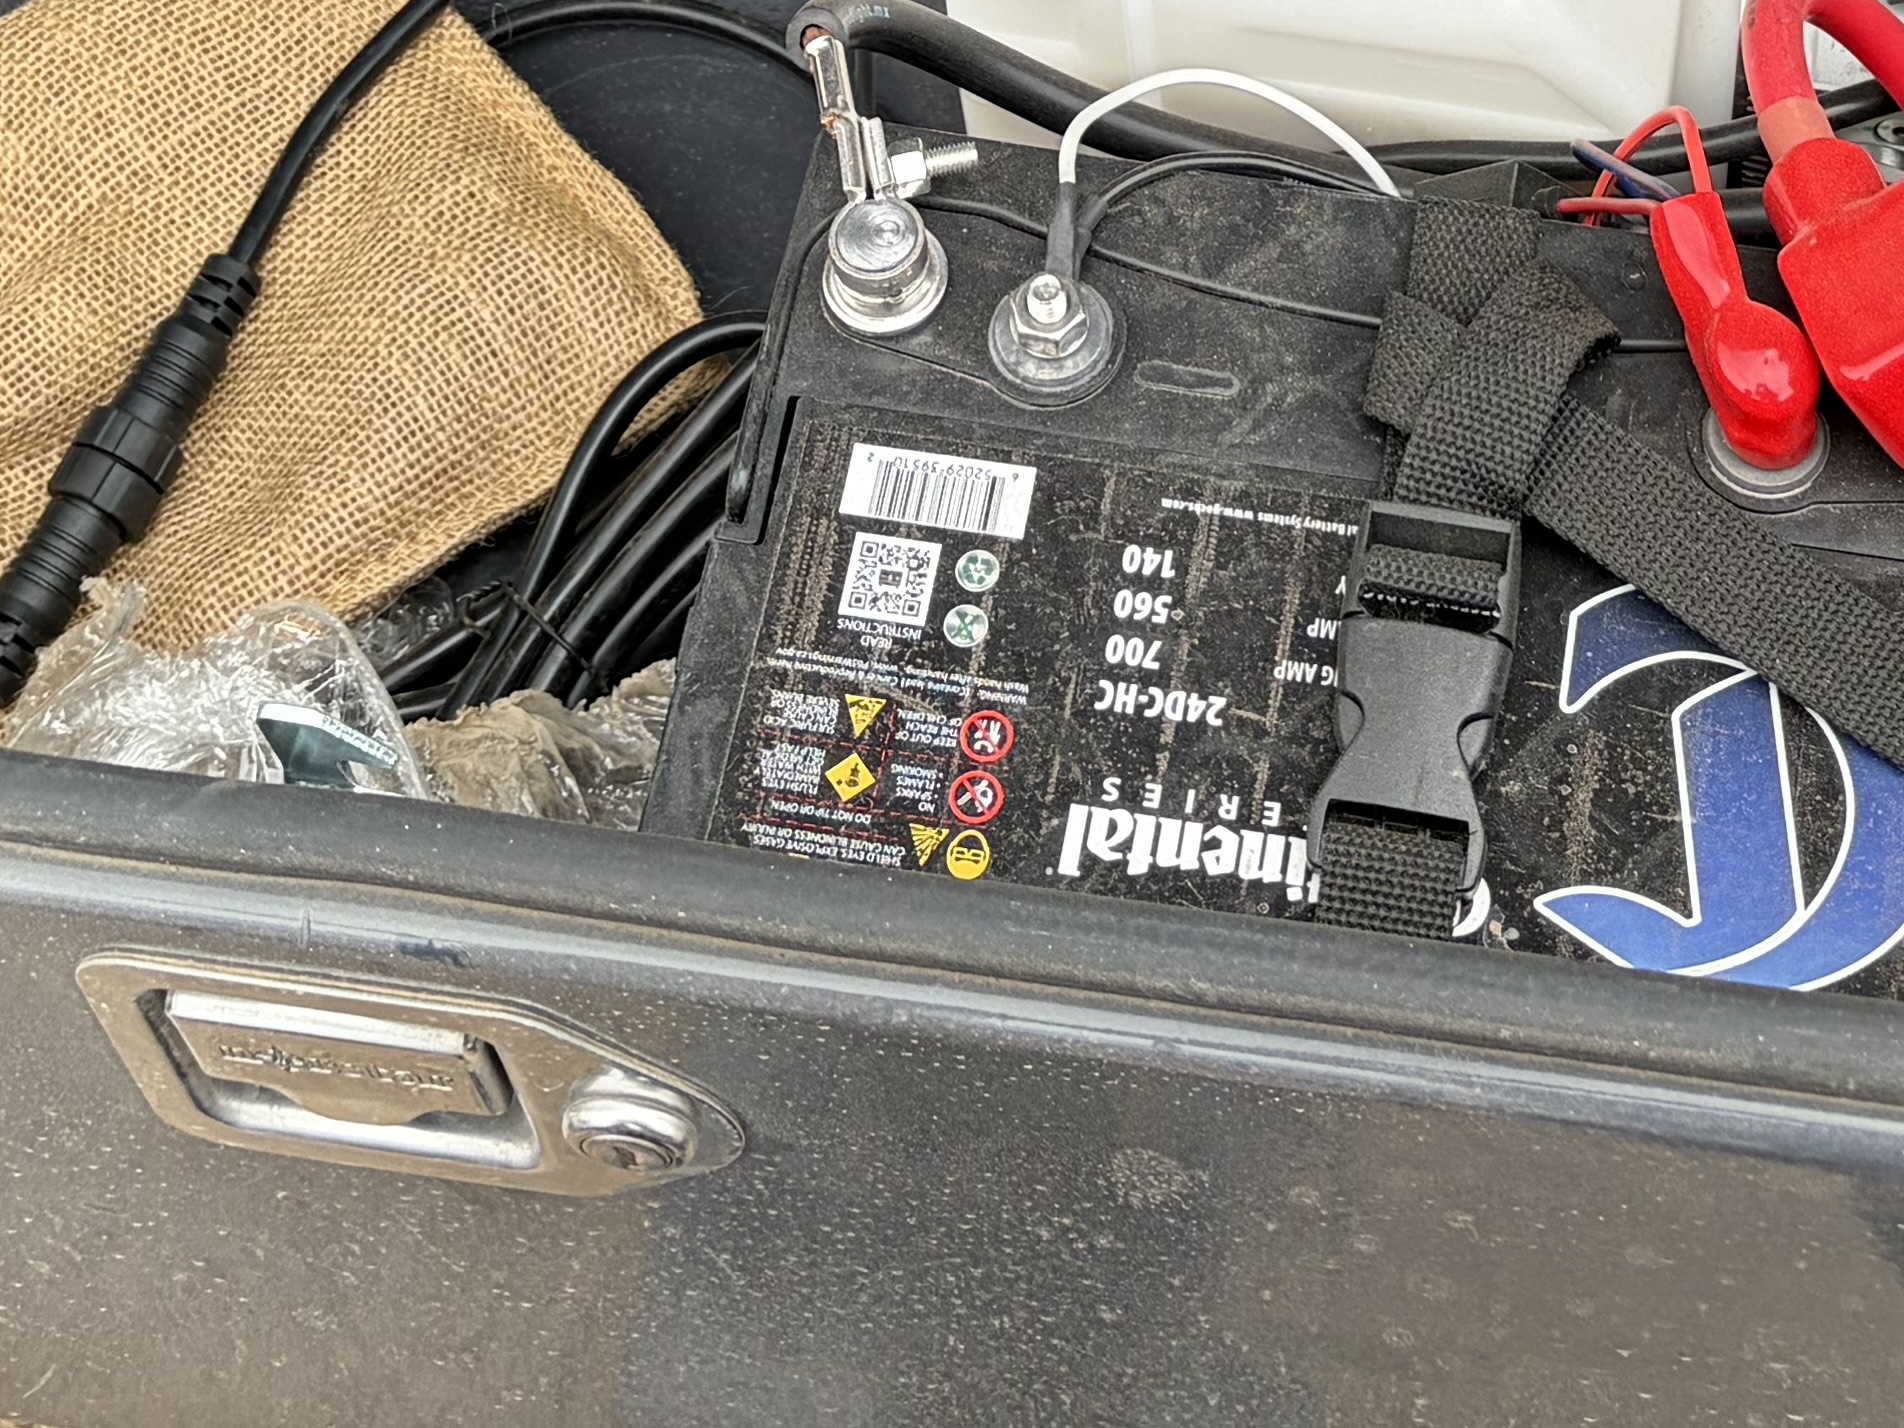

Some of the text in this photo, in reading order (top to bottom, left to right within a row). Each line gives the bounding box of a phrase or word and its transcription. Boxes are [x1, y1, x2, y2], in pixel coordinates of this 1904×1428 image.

[866, 451, 875, 463] 2
[1011, 472, 1021, 483] 6
[1121, 544, 1177, 579] 140
[1113, 588, 1174, 624] 560
[836, 618, 922, 641] INSTRUCTIONS
[1306, 617, 1342, 641] MP
[860, 634, 893, 650] READ
[1104, 634, 1164, 671] 700
[1272, 657, 1318, 684] AMP
[1093, 678, 1229, 727] 24DC-HC
[909, 733, 932, 744] OUT
[918, 801, 936, 813] NO
[1101, 775, 1308, 828] ERIES
[854, 813, 872, 824] DO
